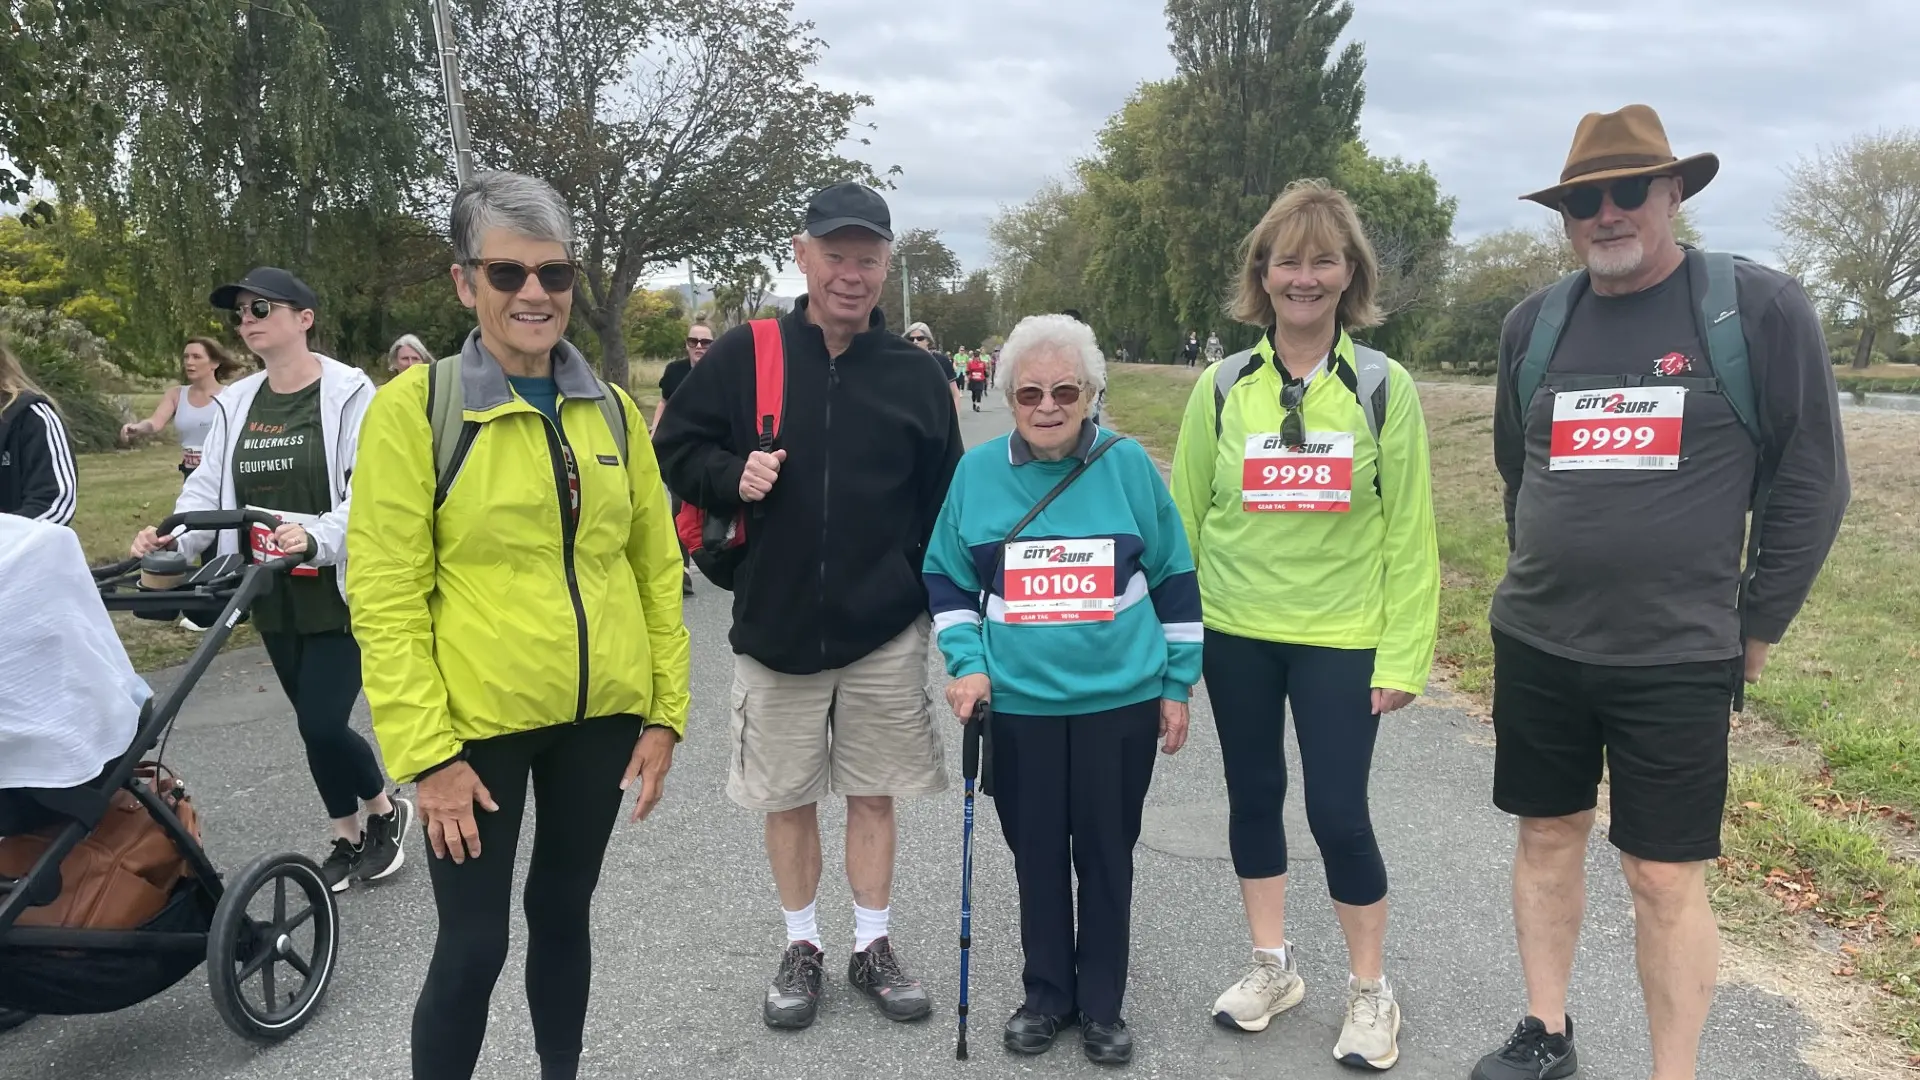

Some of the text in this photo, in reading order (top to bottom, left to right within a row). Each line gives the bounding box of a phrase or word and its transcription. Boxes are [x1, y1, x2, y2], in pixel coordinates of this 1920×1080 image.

[1575, 393, 1659, 414] CITY2SURF
[244, 435, 305, 450] WILDERNESS
[1572, 426, 1655, 451] 9999
[239, 457, 294, 474] EQUIPMENT
[1262, 464, 1332, 485] 9998
[1023, 545, 1094, 563] CITY2SURF
[1021, 573, 1097, 596] 10106
